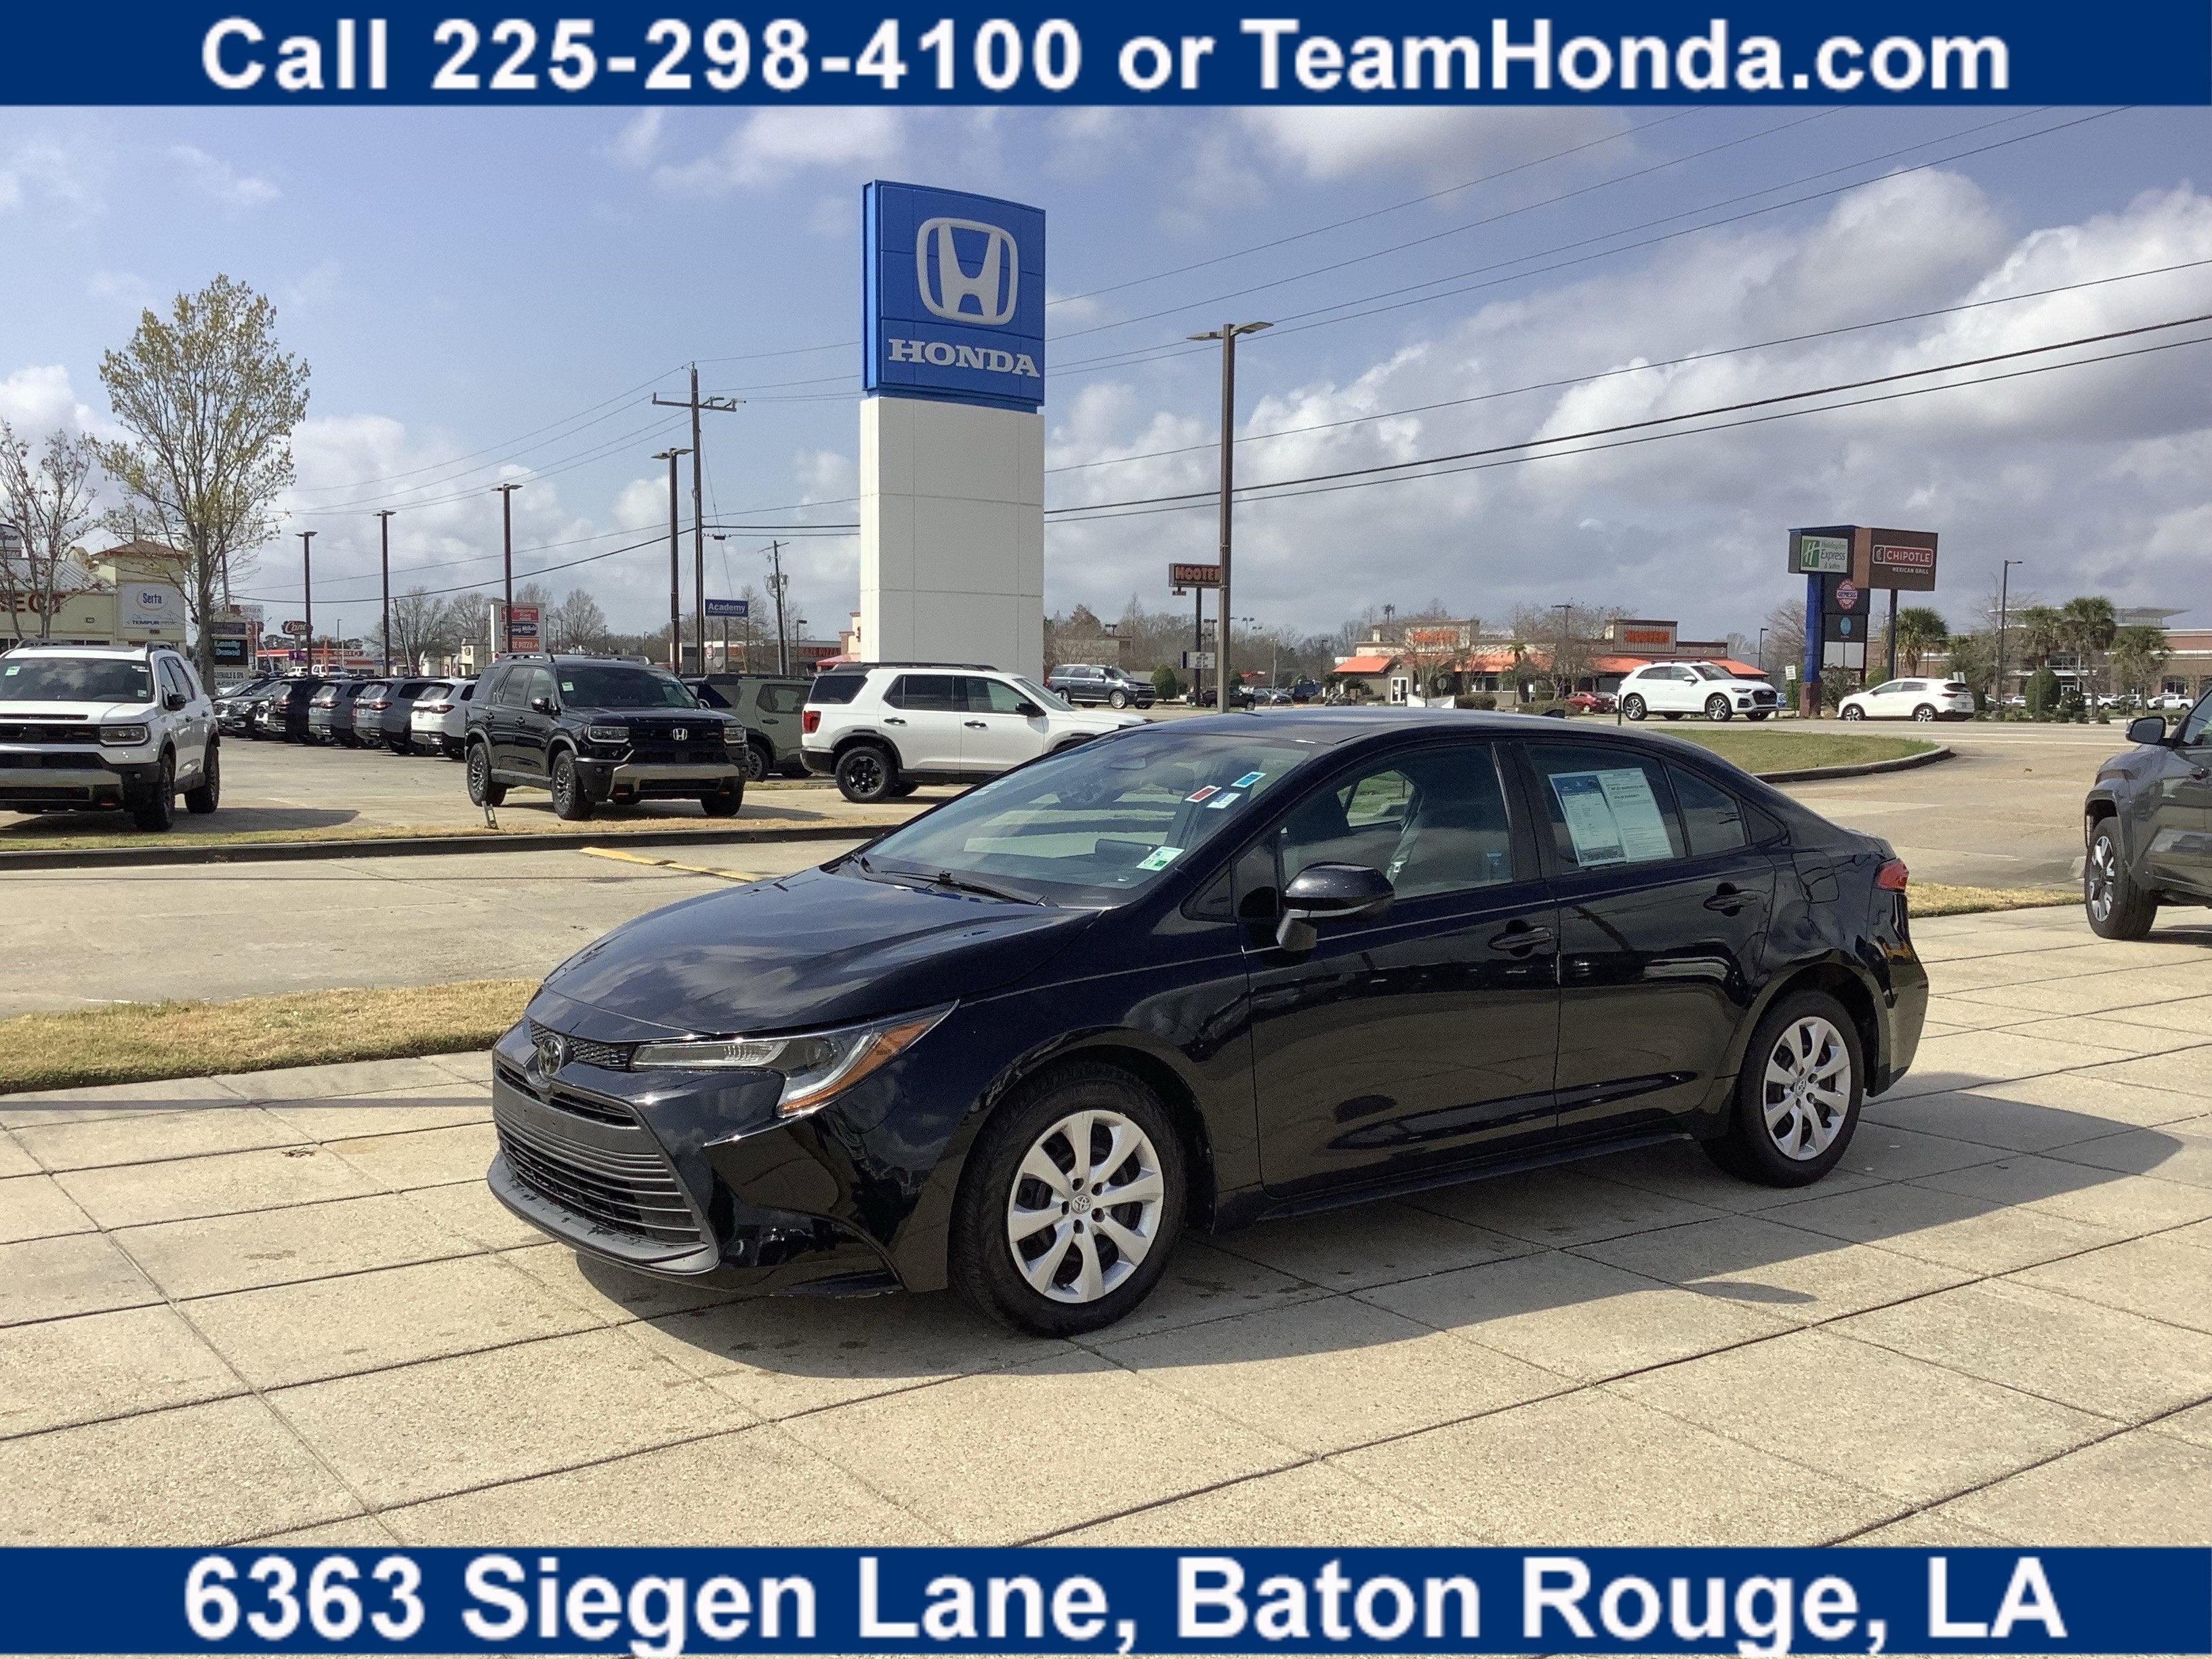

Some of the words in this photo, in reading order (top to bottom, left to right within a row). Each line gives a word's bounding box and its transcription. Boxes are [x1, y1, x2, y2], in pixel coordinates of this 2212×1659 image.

[888, 338, 1041, 378] HONDA
[1821, 549, 1846, 562] Express
[1886, 550, 1931, 563] CHIPOTLE
[0, 592, 66, 614] ECT
[143, 592, 162, 604] Serta
[708, 602, 745, 613] Academy
